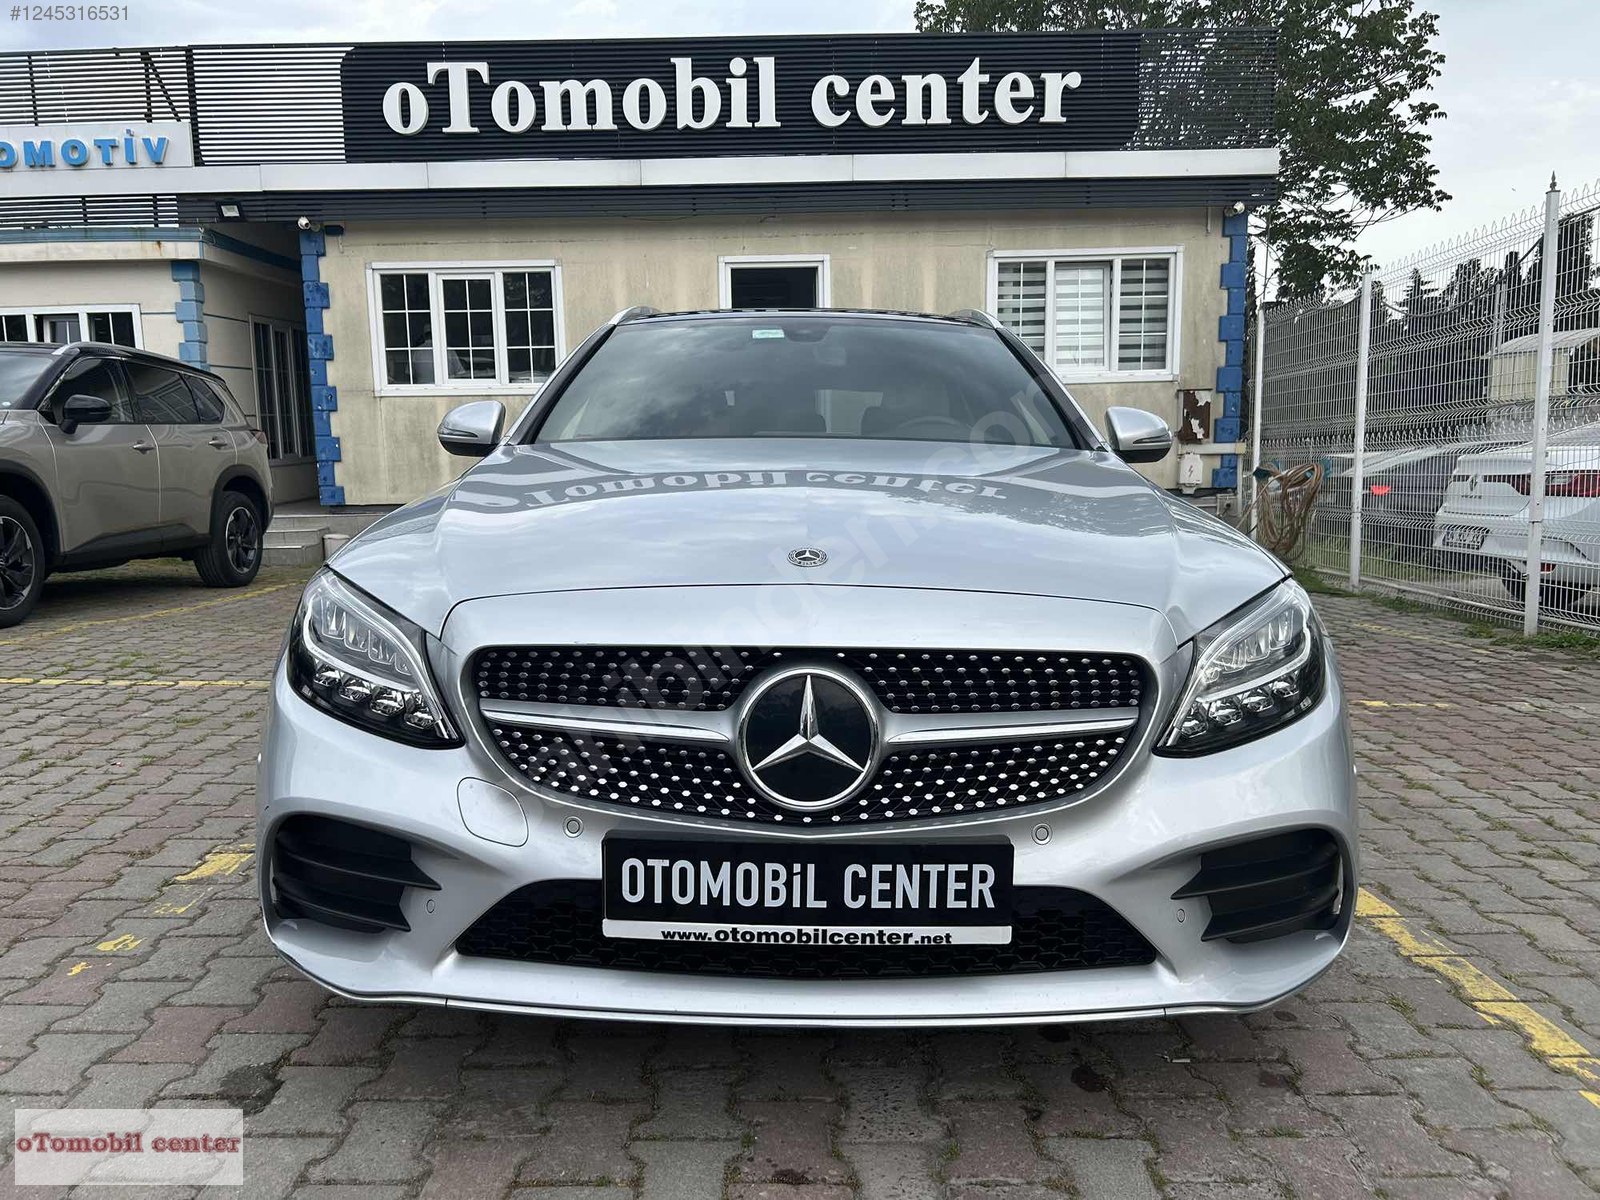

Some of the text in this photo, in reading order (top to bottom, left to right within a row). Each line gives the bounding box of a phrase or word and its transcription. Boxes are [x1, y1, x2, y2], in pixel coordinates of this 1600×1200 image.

[382, 56, 1082, 137] oTomobil center
[843, 863, 996, 909] CENTER
[660, 926, 953, 946] www.otomobilcenter.net
